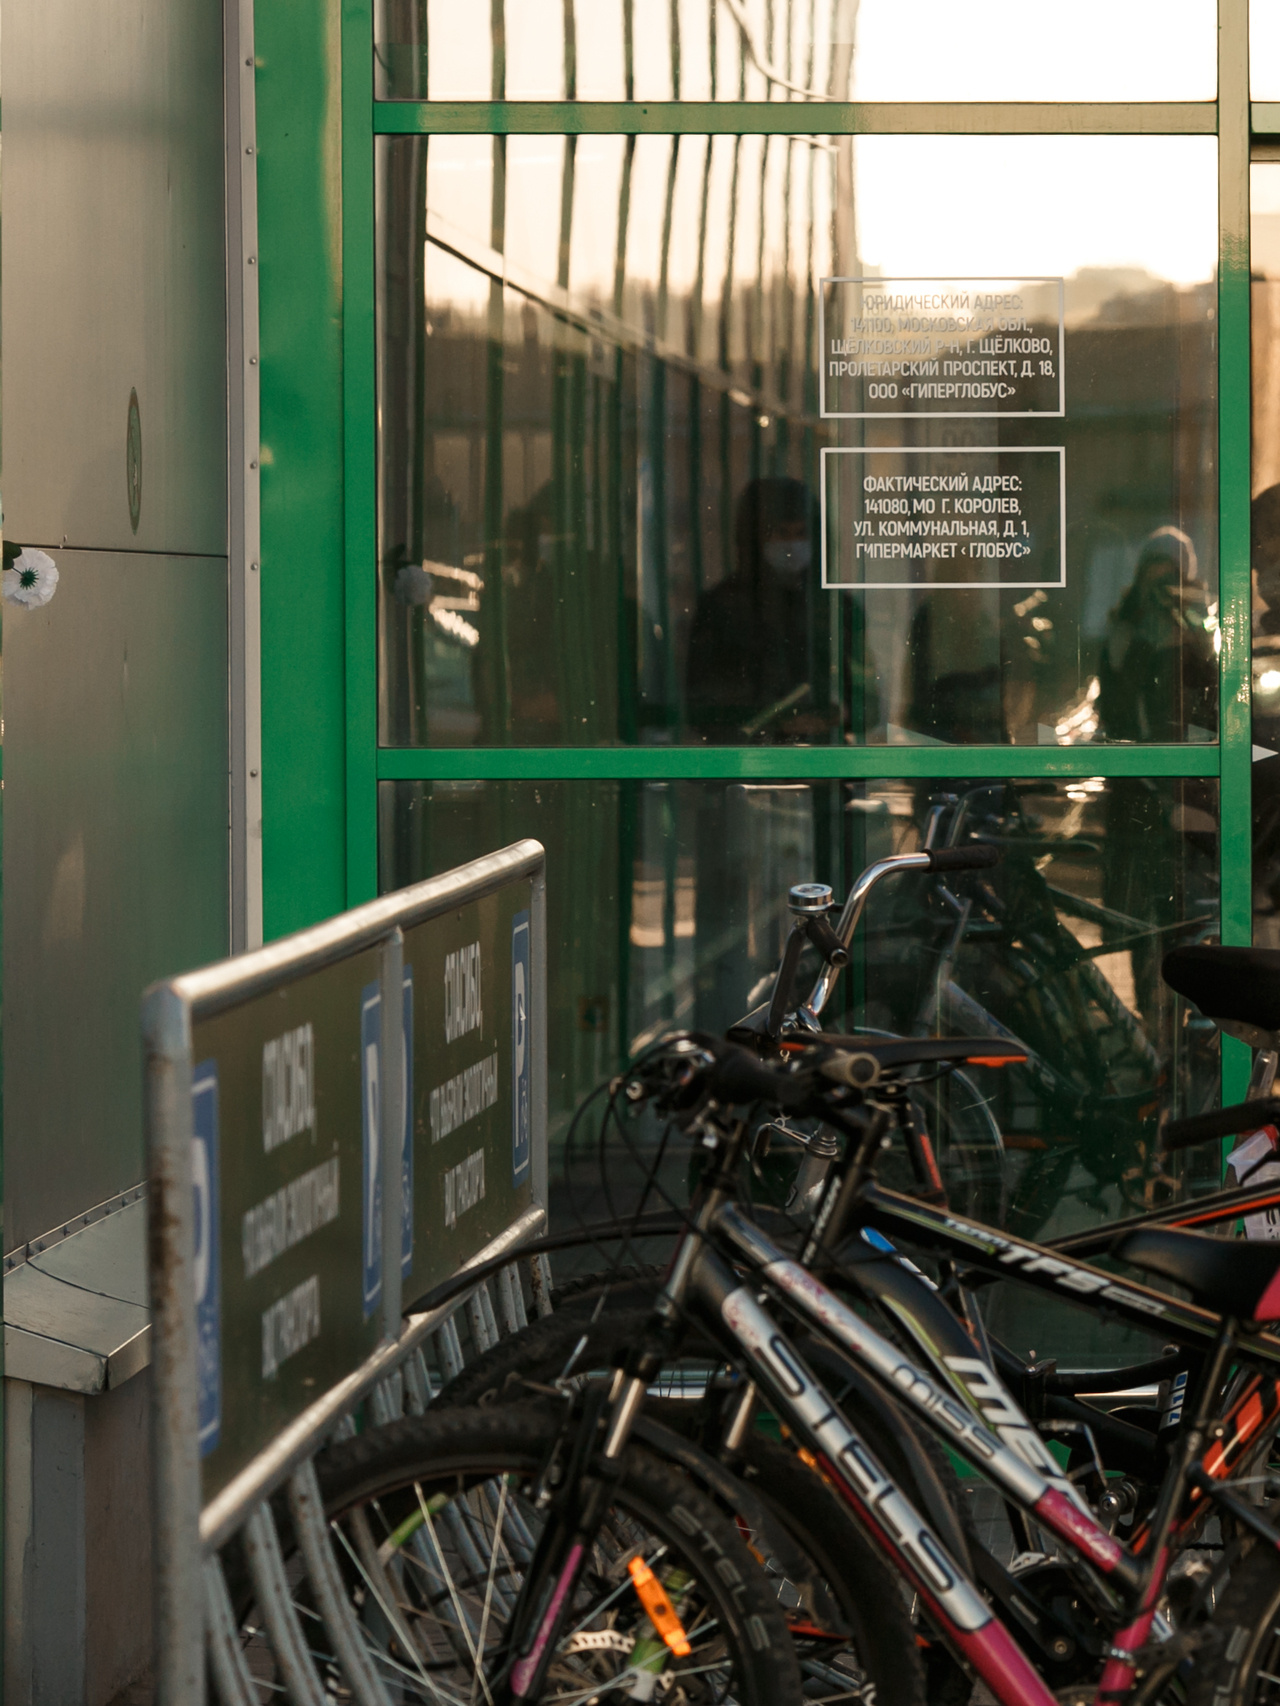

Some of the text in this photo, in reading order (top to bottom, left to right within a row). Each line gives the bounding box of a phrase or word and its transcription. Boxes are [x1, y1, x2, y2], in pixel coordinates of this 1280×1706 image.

[861, 291, 1024, 311] ЮРИДИЧЕСКИЙ АДРЕС:
[899, 316, 994, 332] МОСКОВСКАЯ
[830, 336, 932, 357] ЩЁЛКОВСКИЙ
[966, 338, 977, 355] Г.
[979, 336, 1054, 356] ЩЁЛКОВО,
[829, 358, 1056, 378] ПРОЛЕТАРСКИЙ ПРОСПЕКТ, Д. 18,
[868, 382, 1017, 399] ООО «ГИПЕРГЛОБУС»
[863, 472, 1023, 494] ФАКТИЧЕСКИЙ АДРЕС:
[864, 498, 1022, 516] 141080, МО Г. КОРОЛЕВ,
[853, 520, 1031, 538] УЛ. КОММУНАЛЬНАЯ, Д. 1,
[855, 542, 958, 559] ГИПЕРМАРКЕТ
[755, 1334, 962, 1592] STELS
